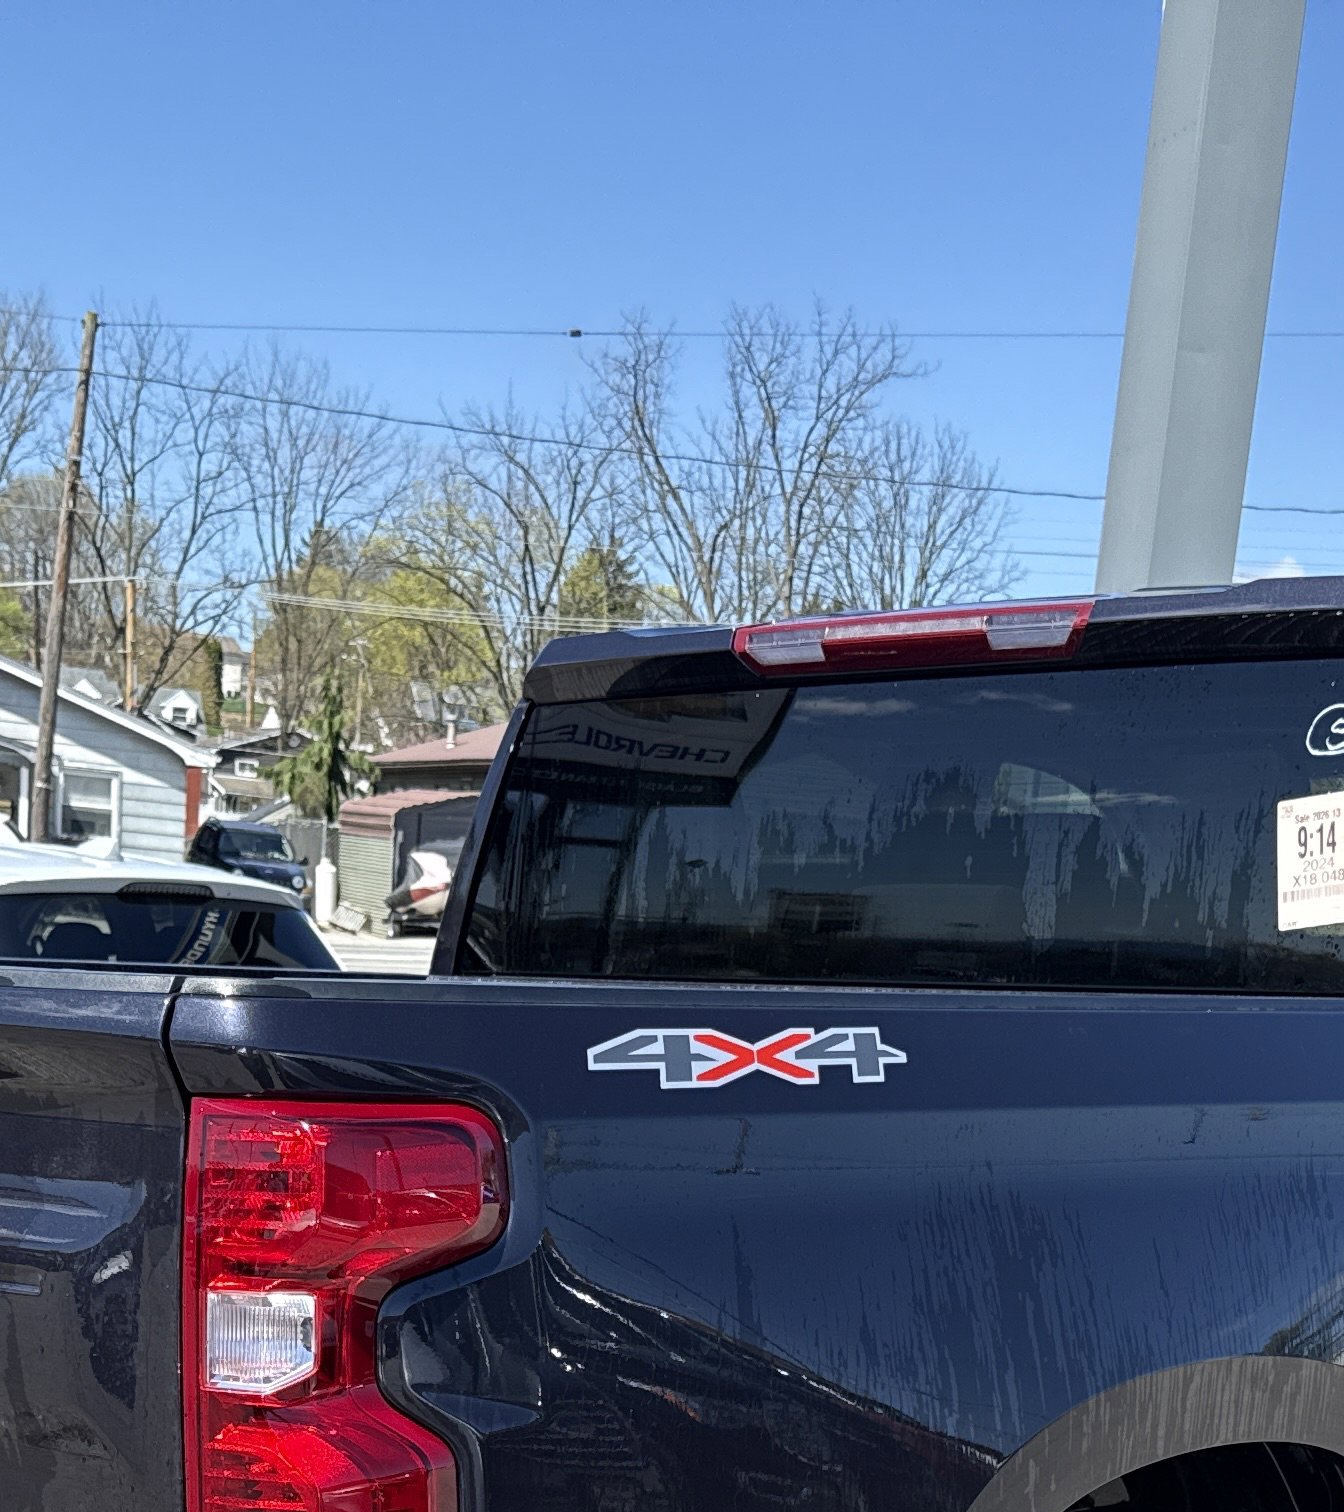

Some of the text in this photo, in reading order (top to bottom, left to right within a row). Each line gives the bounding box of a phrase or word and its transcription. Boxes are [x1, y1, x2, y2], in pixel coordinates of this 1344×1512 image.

[1297, 820, 1337, 859] 9:14
[1302, 856, 1335, 873] 2024
[1292, 872, 1318, 889] X18
